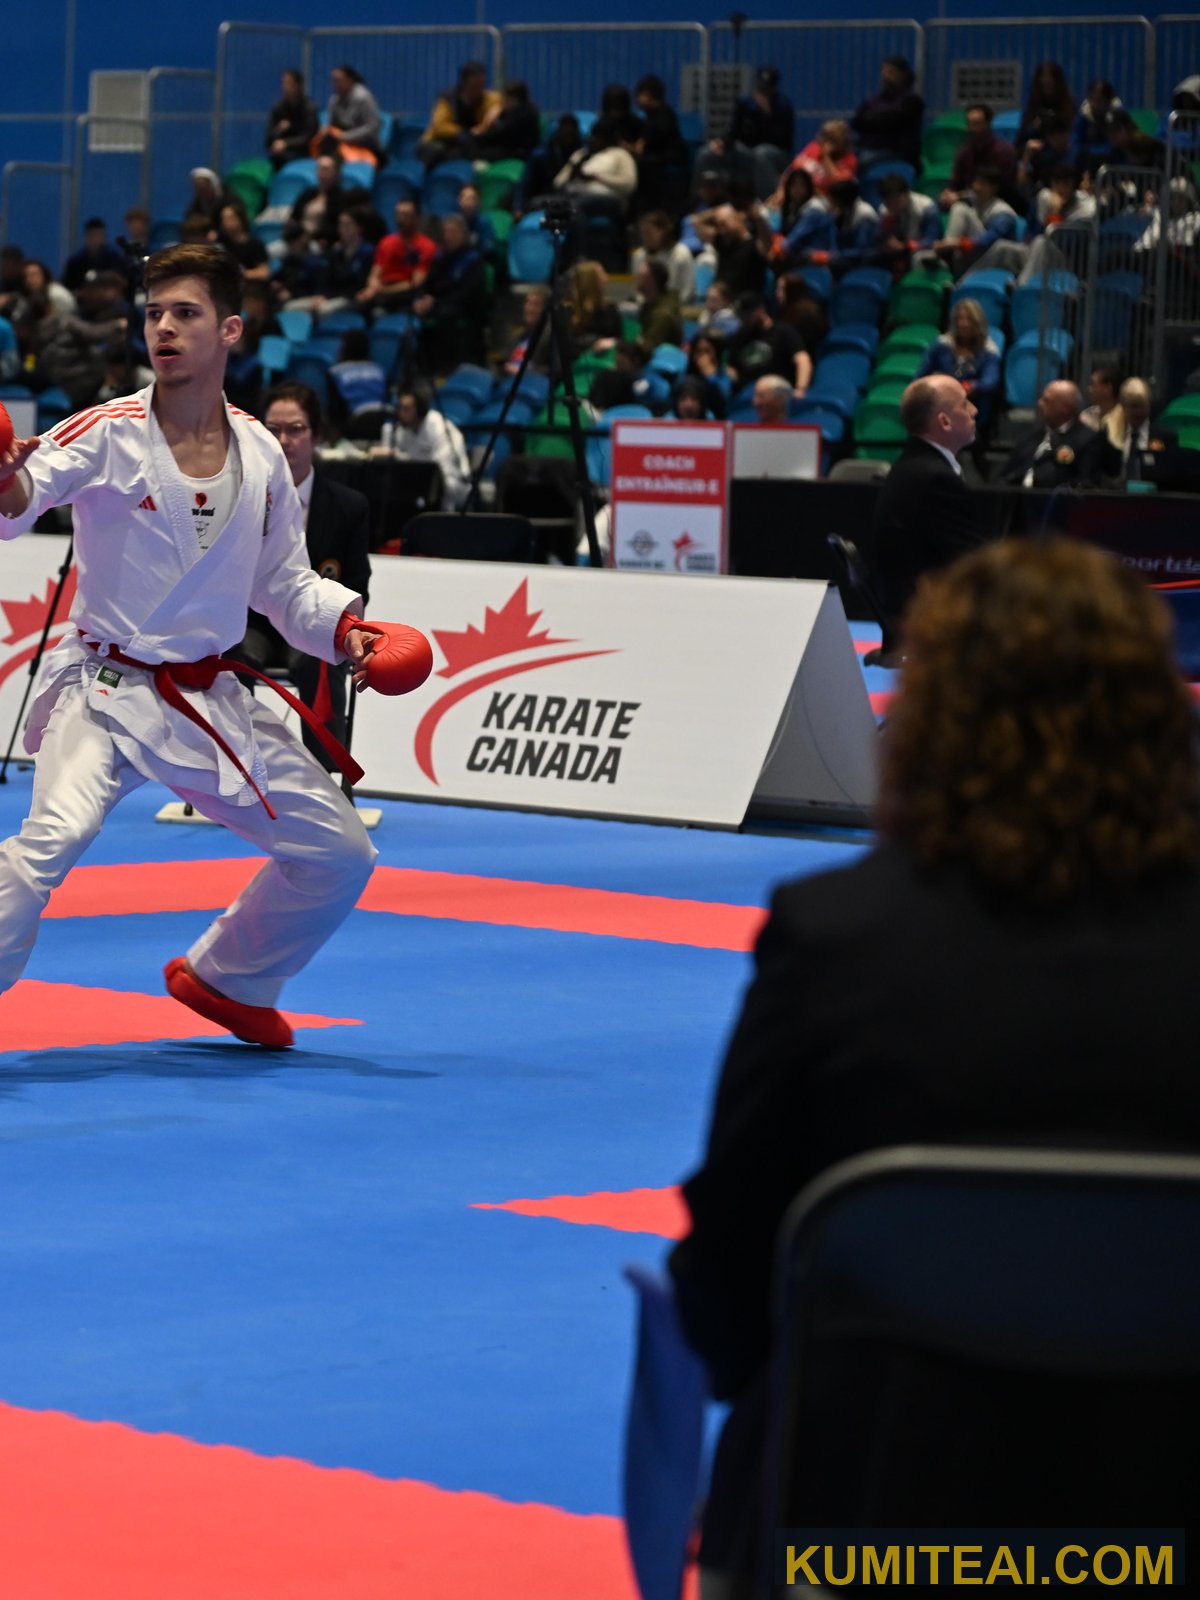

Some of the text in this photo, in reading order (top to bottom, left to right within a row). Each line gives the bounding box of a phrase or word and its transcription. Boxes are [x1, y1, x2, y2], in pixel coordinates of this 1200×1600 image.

[643, 454, 695, 470] COACH
[481, 691, 642, 740] KARATE
[466, 735, 622, 784] CANADA
